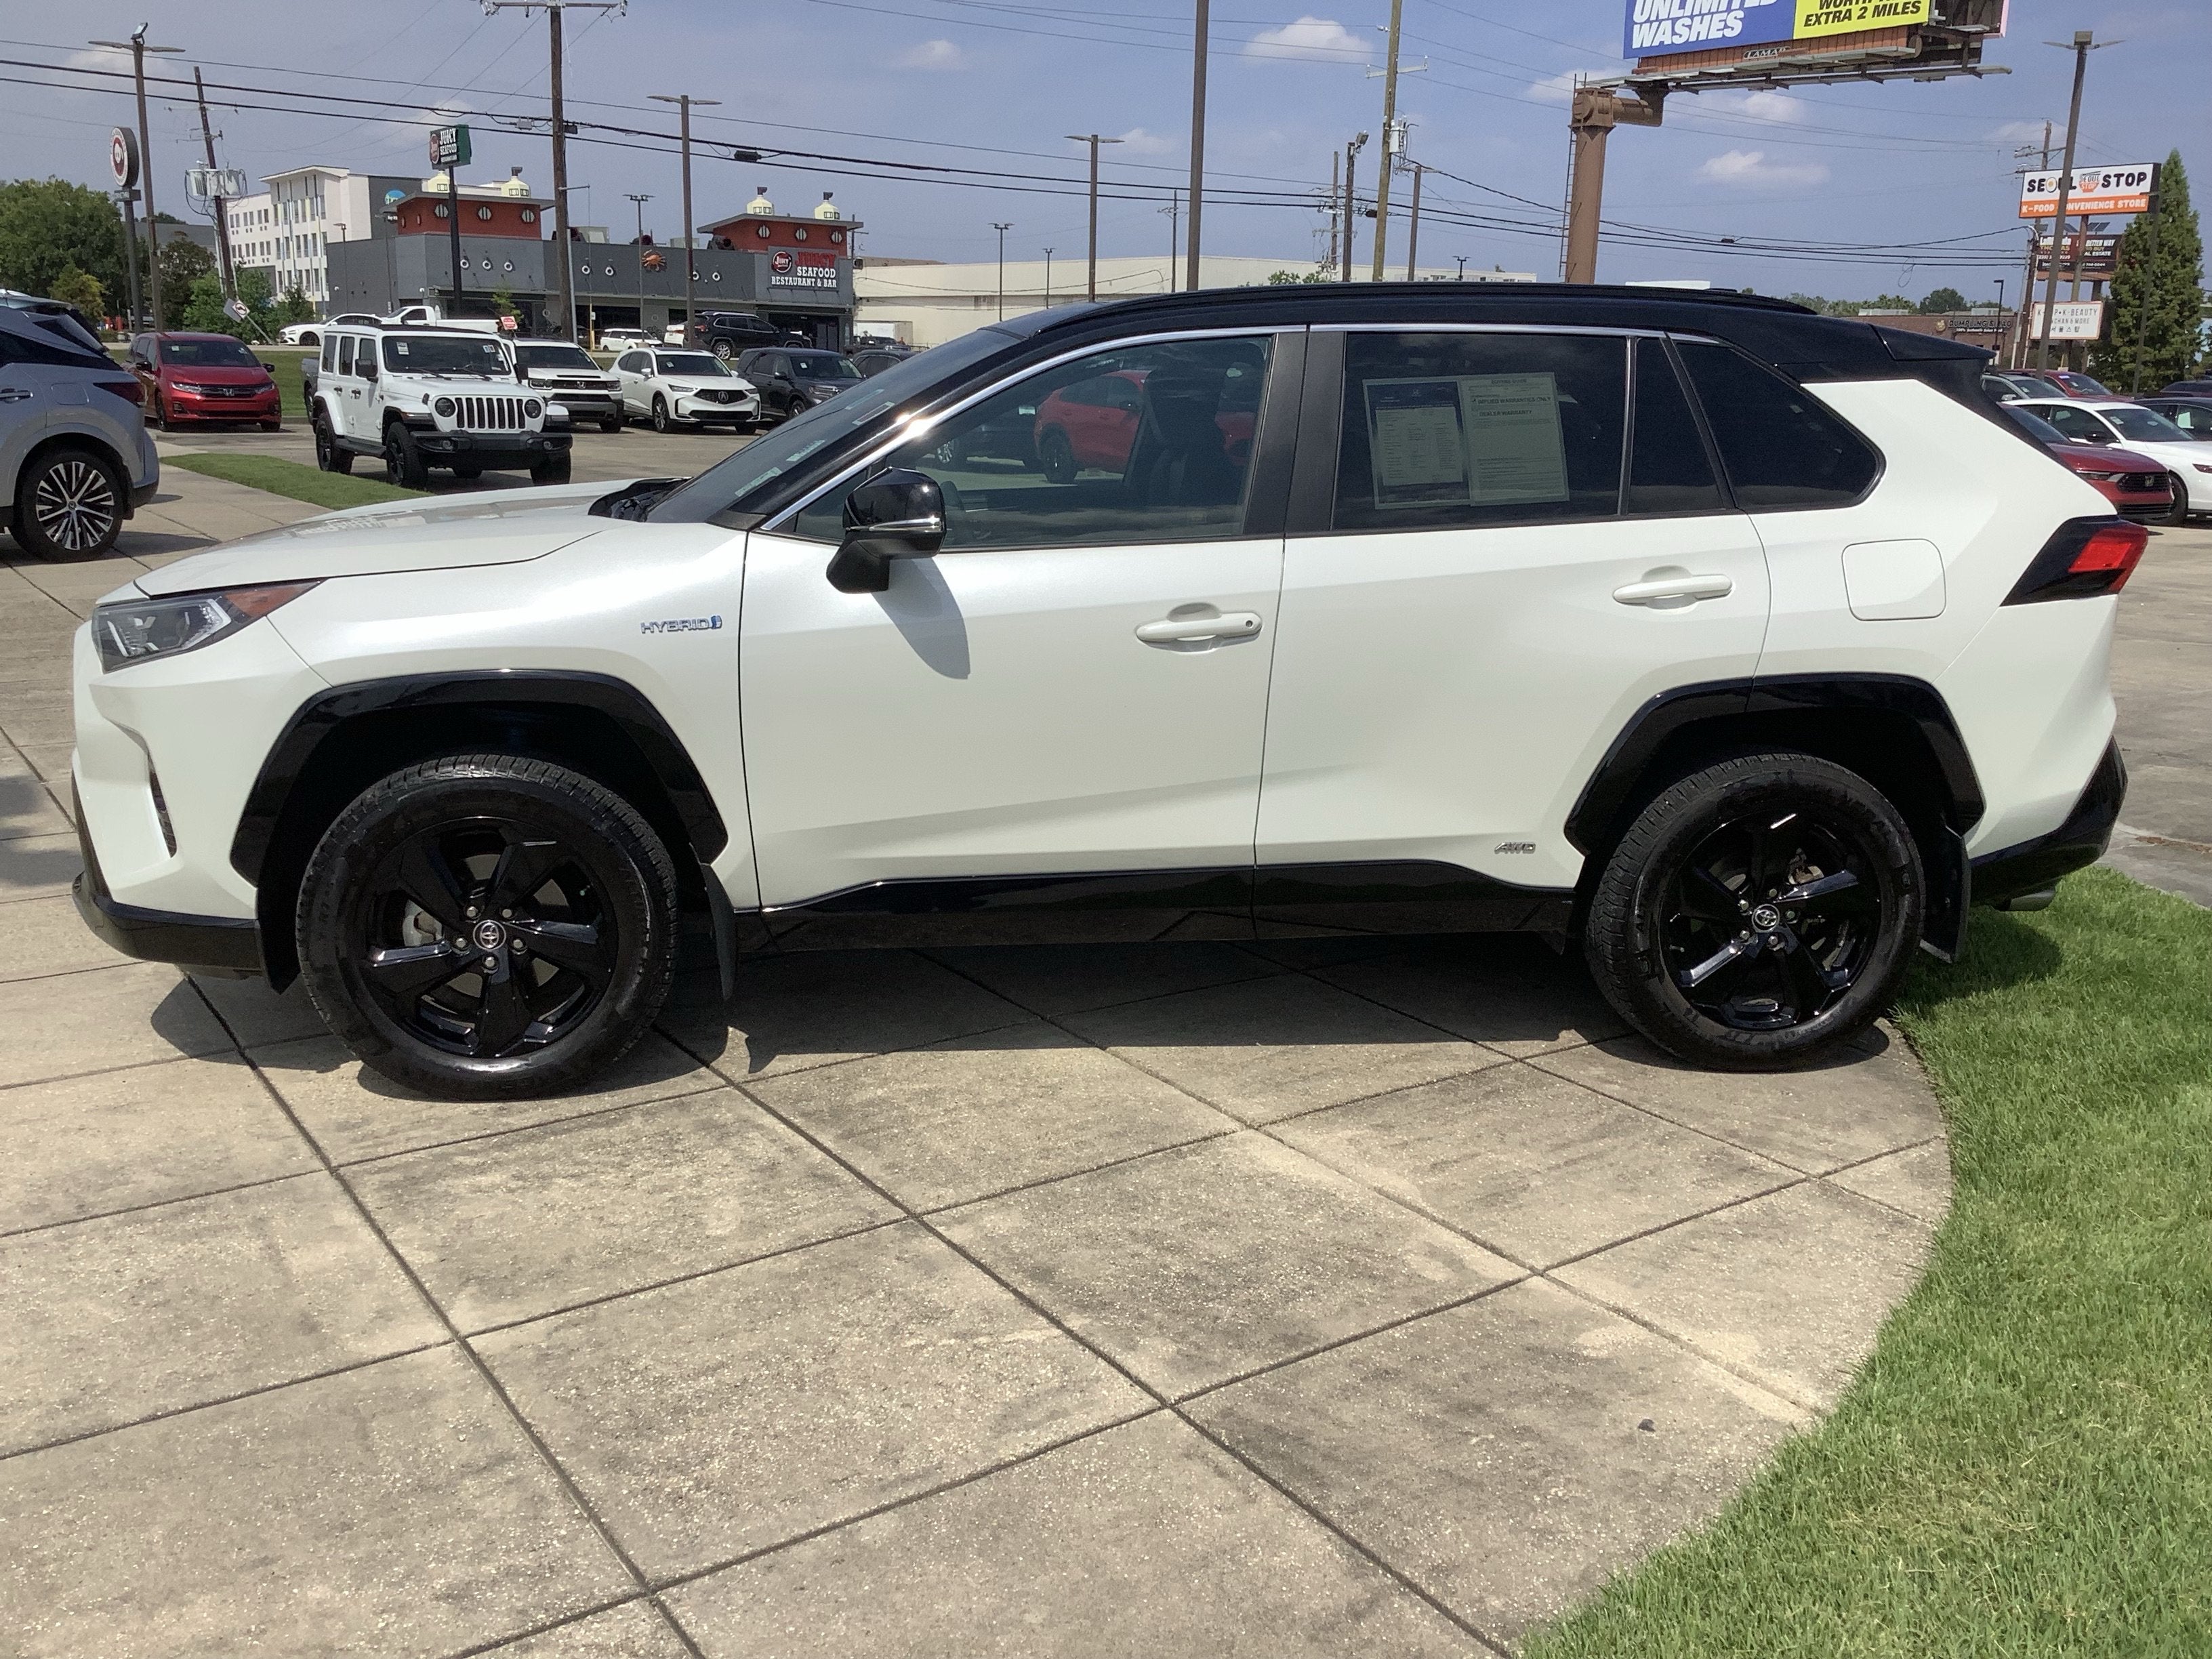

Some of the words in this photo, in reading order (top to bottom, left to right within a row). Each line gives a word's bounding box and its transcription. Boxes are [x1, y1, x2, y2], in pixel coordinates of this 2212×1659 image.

[1803, 9, 1852, 27] EXTRA
[1857, 6, 1868, 20] 2
[1872, 1, 1921, 18] MILES
[1632, 10, 1744, 49] WASHES
[439, 128, 456, 145] JUICY
[2102, 172, 2147, 188] STOP
[2022, 204, 2055, 213] K-FOOD
[2117, 199, 2146, 208] STORE
[795, 251, 836, 268] JUICY
[797, 266, 836, 278] SEAFOOD
[771, 276, 815, 286] RESTAURANT
[817, 279, 821, 287] &
[823, 279, 837, 288] BAR
[641, 617, 710, 634] HYBRID
[1494, 842, 1536, 854] AWD
